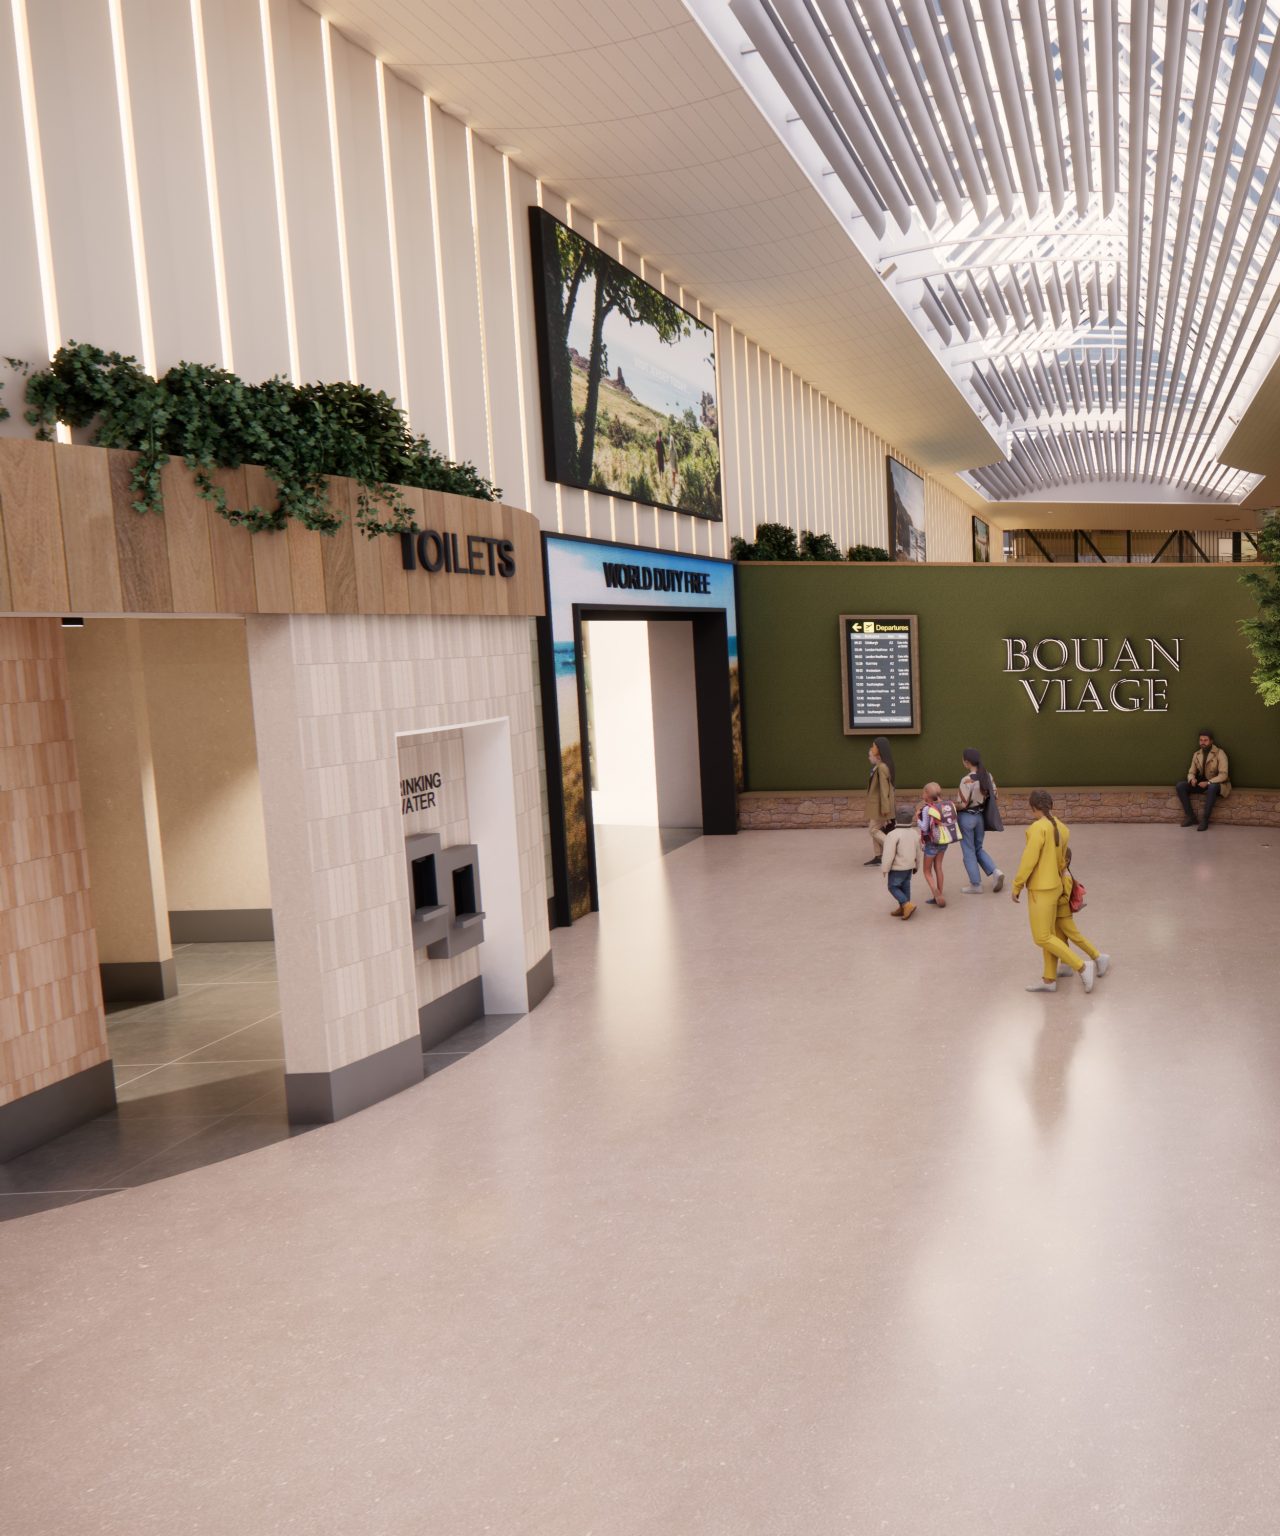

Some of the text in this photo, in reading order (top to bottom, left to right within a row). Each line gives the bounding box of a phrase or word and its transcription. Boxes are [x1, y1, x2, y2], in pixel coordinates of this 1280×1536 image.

[398, 529, 516, 578] TOILETS
[603, 562, 711, 595] WORLD DUTY FREE
[876, 624, 909, 632] Departures
[1001, 637, 1185, 673] BOUAN
[1018, 678, 1169, 714] VIAGE
[400, 772, 442, 797] INKING
[402, 792, 436, 815] ATER
